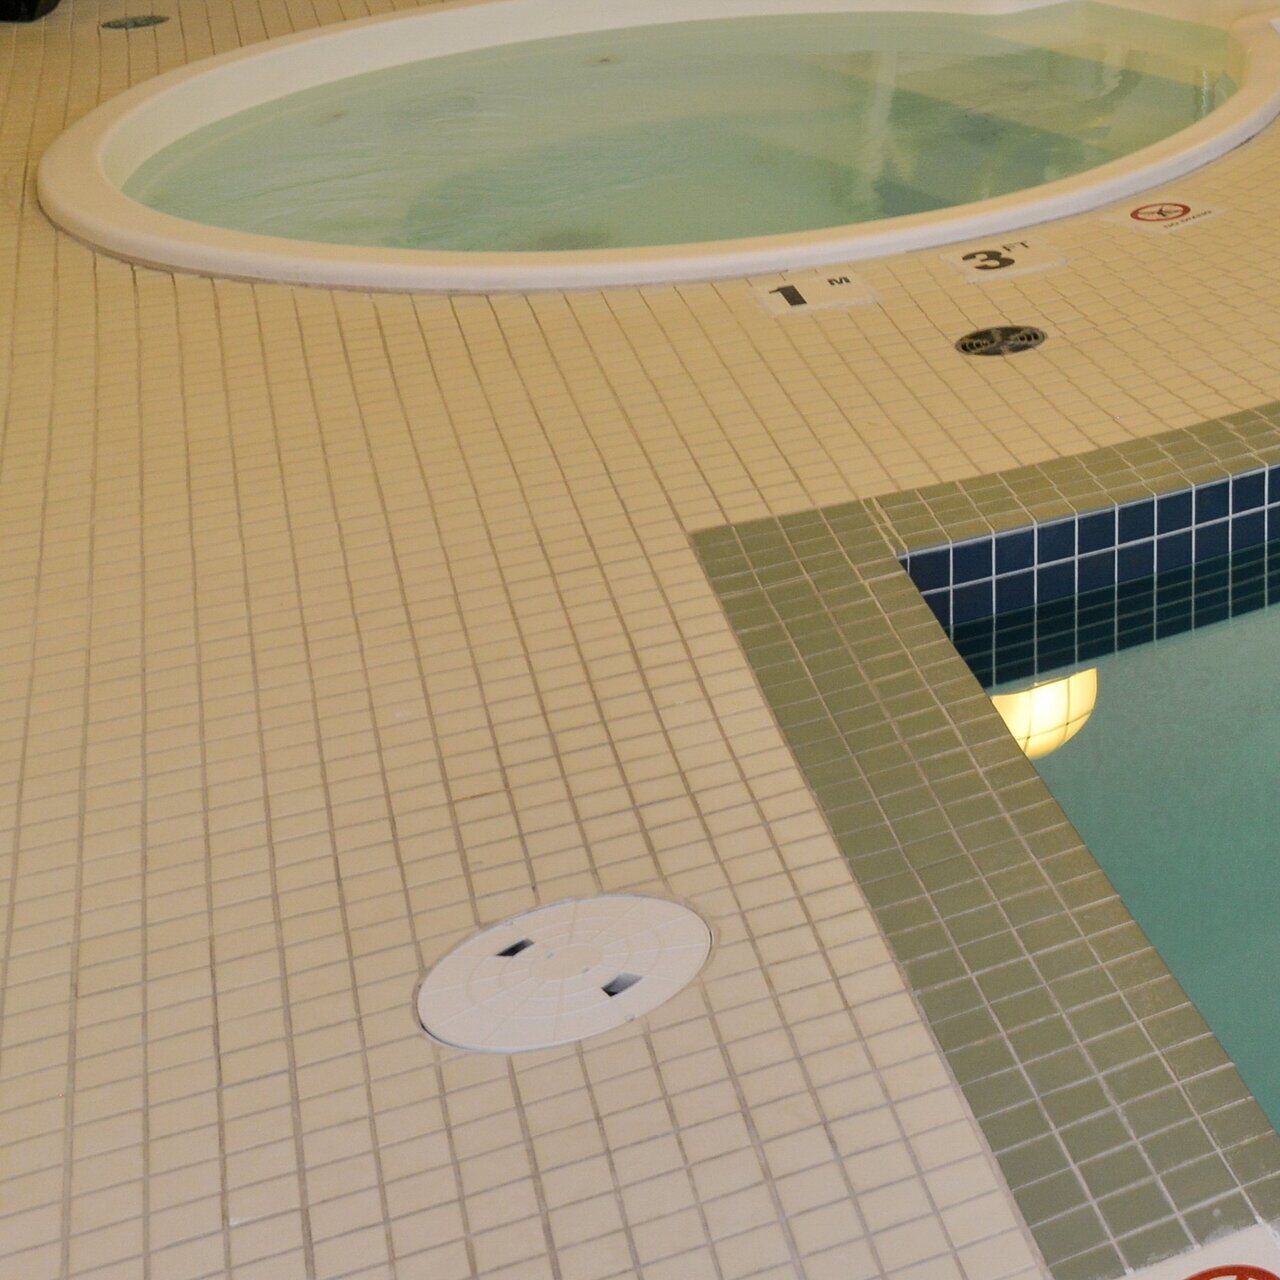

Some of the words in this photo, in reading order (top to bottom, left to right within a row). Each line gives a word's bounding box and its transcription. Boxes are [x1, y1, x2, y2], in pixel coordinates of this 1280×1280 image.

[962, 250, 1015, 270] 3
[1003, 241, 1029, 252] FT
[768, 285, 807, 306] 1
[827, 276, 850, 286] M
